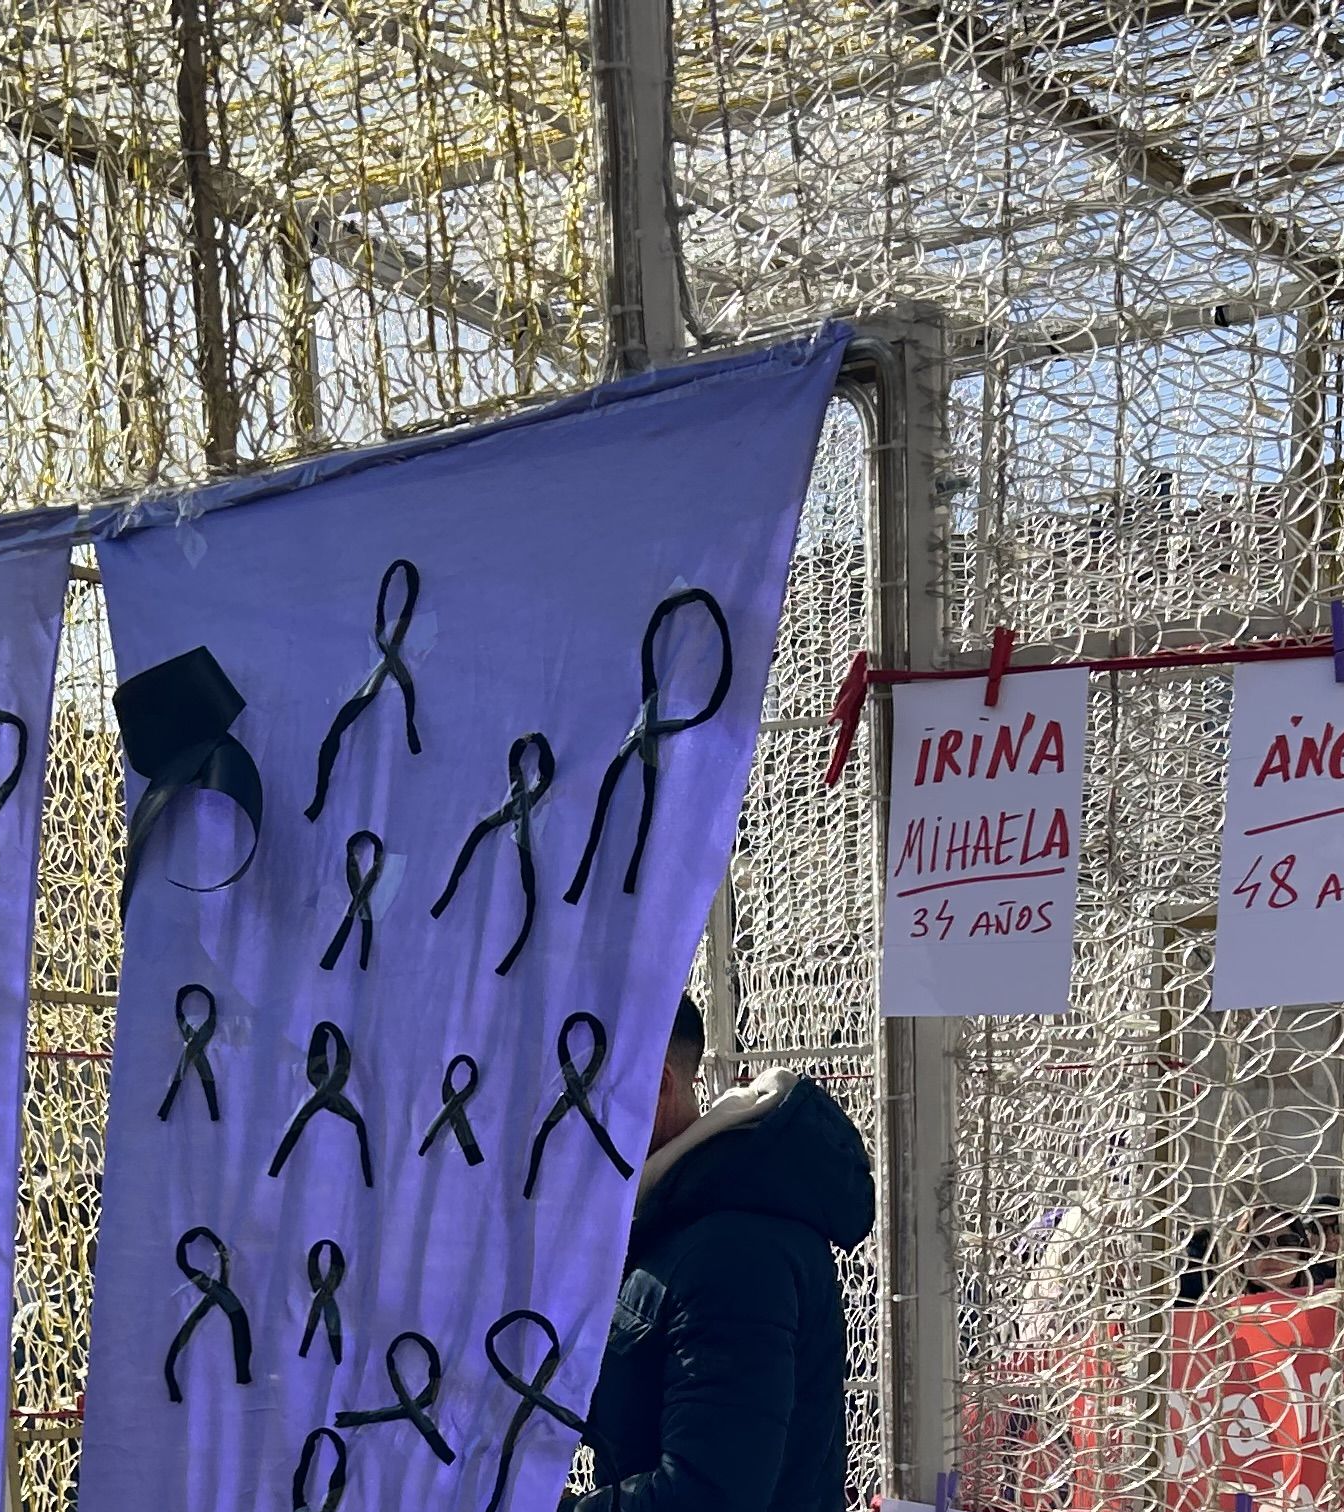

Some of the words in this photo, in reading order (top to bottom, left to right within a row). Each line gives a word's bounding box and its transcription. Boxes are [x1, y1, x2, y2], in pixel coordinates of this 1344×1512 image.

[914, 712, 1065, 787] IRINA
[894, 808, 1069, 877] MIHAELA
[1232, 855, 1297, 909] 48
[911, 900, 954, 941] 34
[969, 900, 1054, 937] AÑOS
